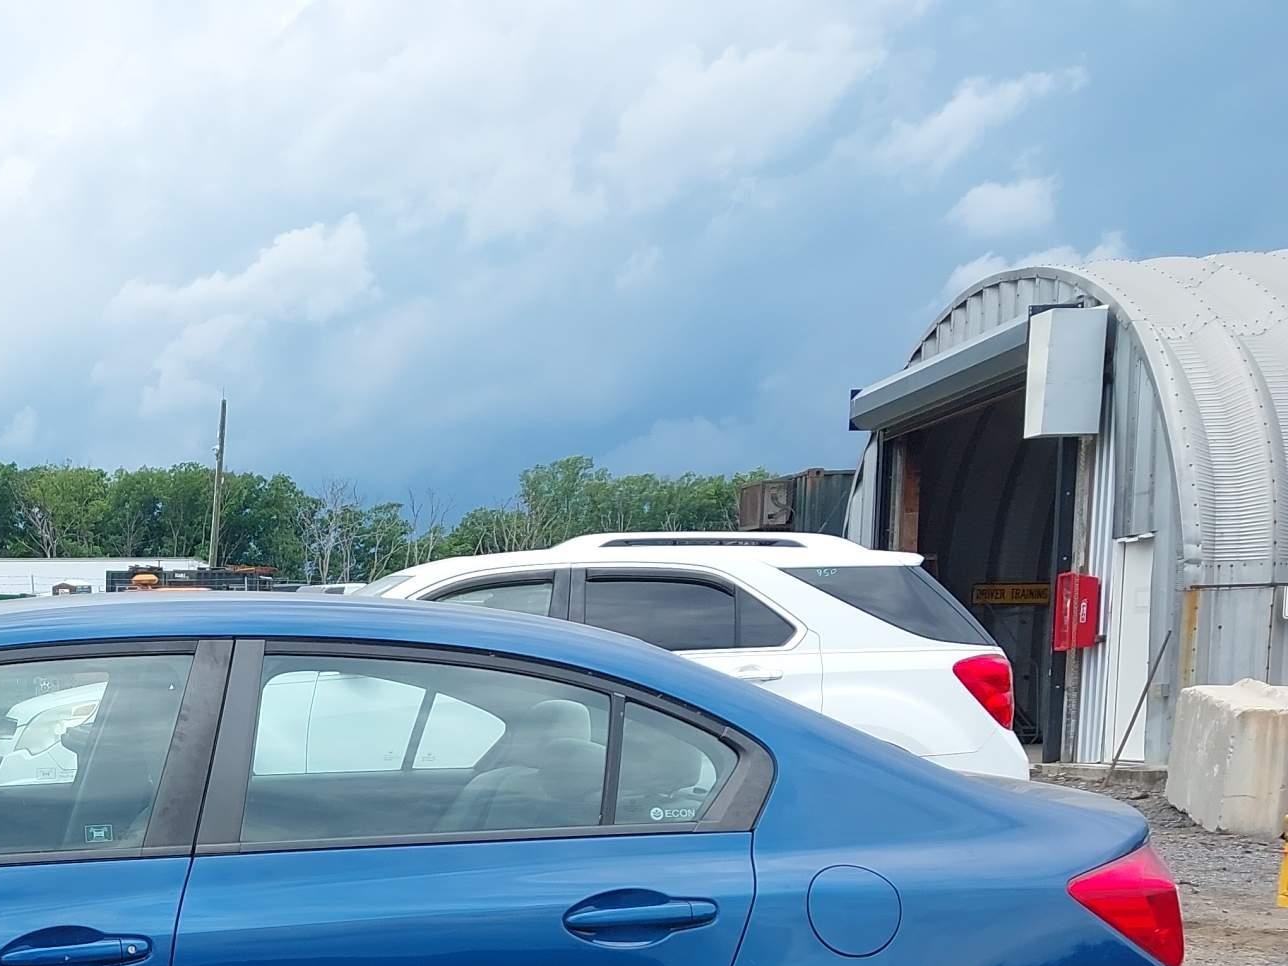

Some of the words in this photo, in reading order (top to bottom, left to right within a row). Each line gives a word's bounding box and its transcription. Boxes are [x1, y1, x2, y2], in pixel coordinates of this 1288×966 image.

[975, 588, 1007, 601] DRIVER
[1011, 588, 1049, 601] TRAINING
[664, 808, 695, 818] ECON
